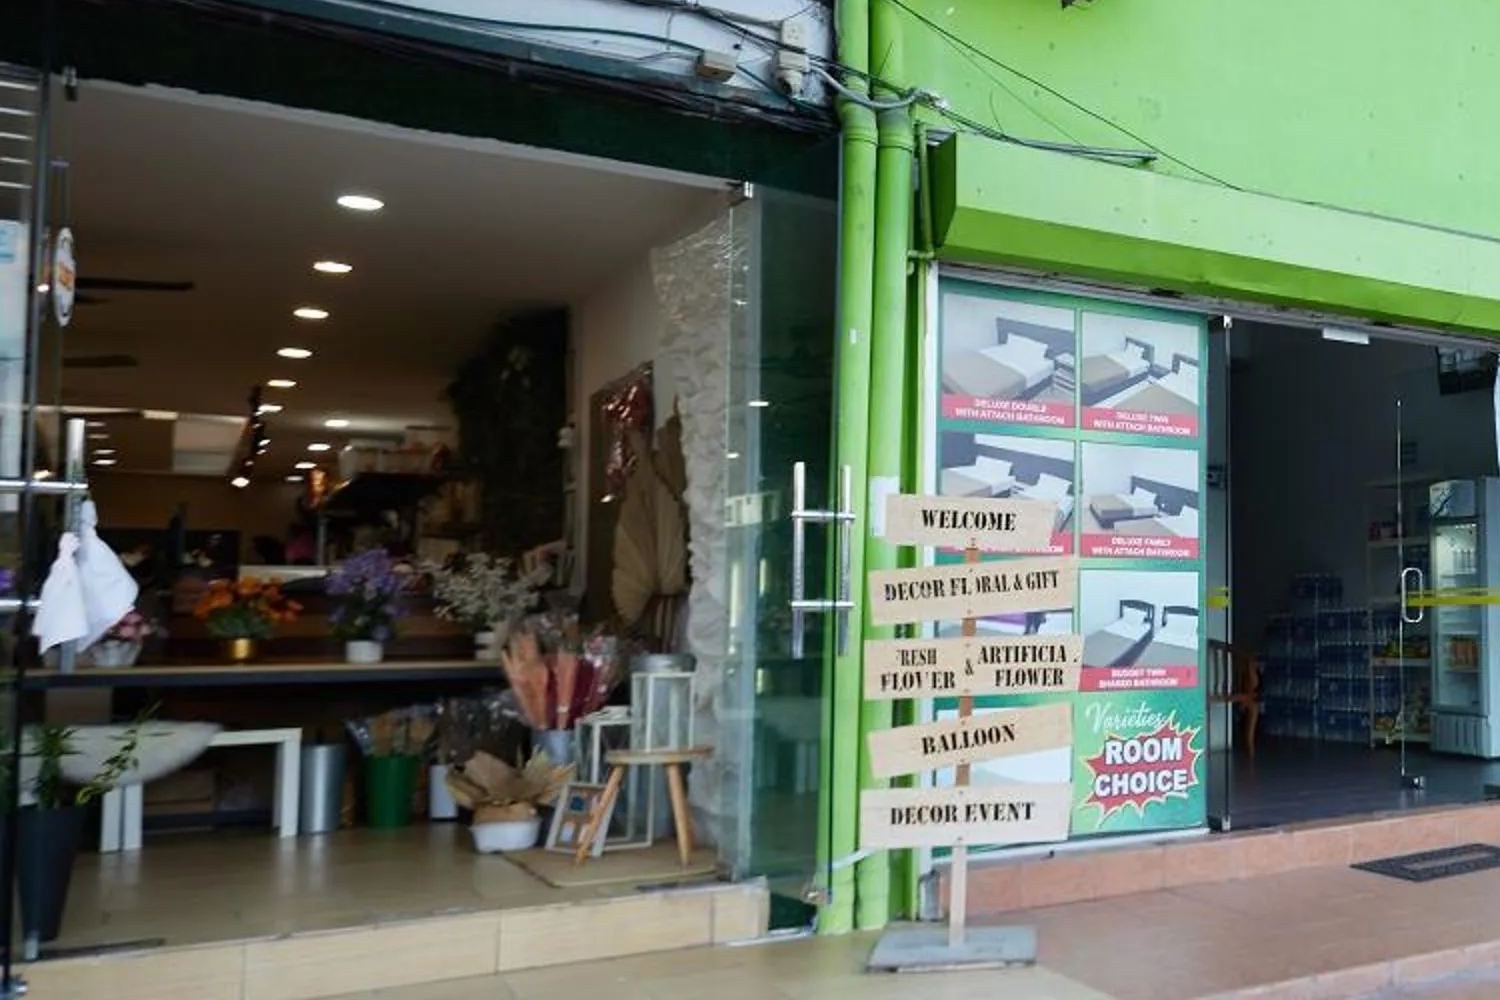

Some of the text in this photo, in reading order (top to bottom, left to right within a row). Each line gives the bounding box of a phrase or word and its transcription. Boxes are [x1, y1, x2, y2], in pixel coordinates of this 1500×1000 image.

[956, 408, 978, 419] WITH
[980, 410, 1014, 421] ATTACH
[974, 398, 1009, 411] DELUXE
[921, 509, 1017, 532] WELCOME
[884, 580, 945, 602] DECOR
[1013, 573, 1024, 592] &
[1025, 569, 1060, 591] GIFT
[964, 659, 975, 677] &
[994, 667, 1065, 688] FLOWER
[1085, 700, 1168, 734] Varieties
[920, 723, 1016, 756] BALLOON
[1104, 737, 1183, 765] ROOM
[1095, 769, 1188, 798] CHOICE
[890, 801, 1037, 826] DECOR EVENT
